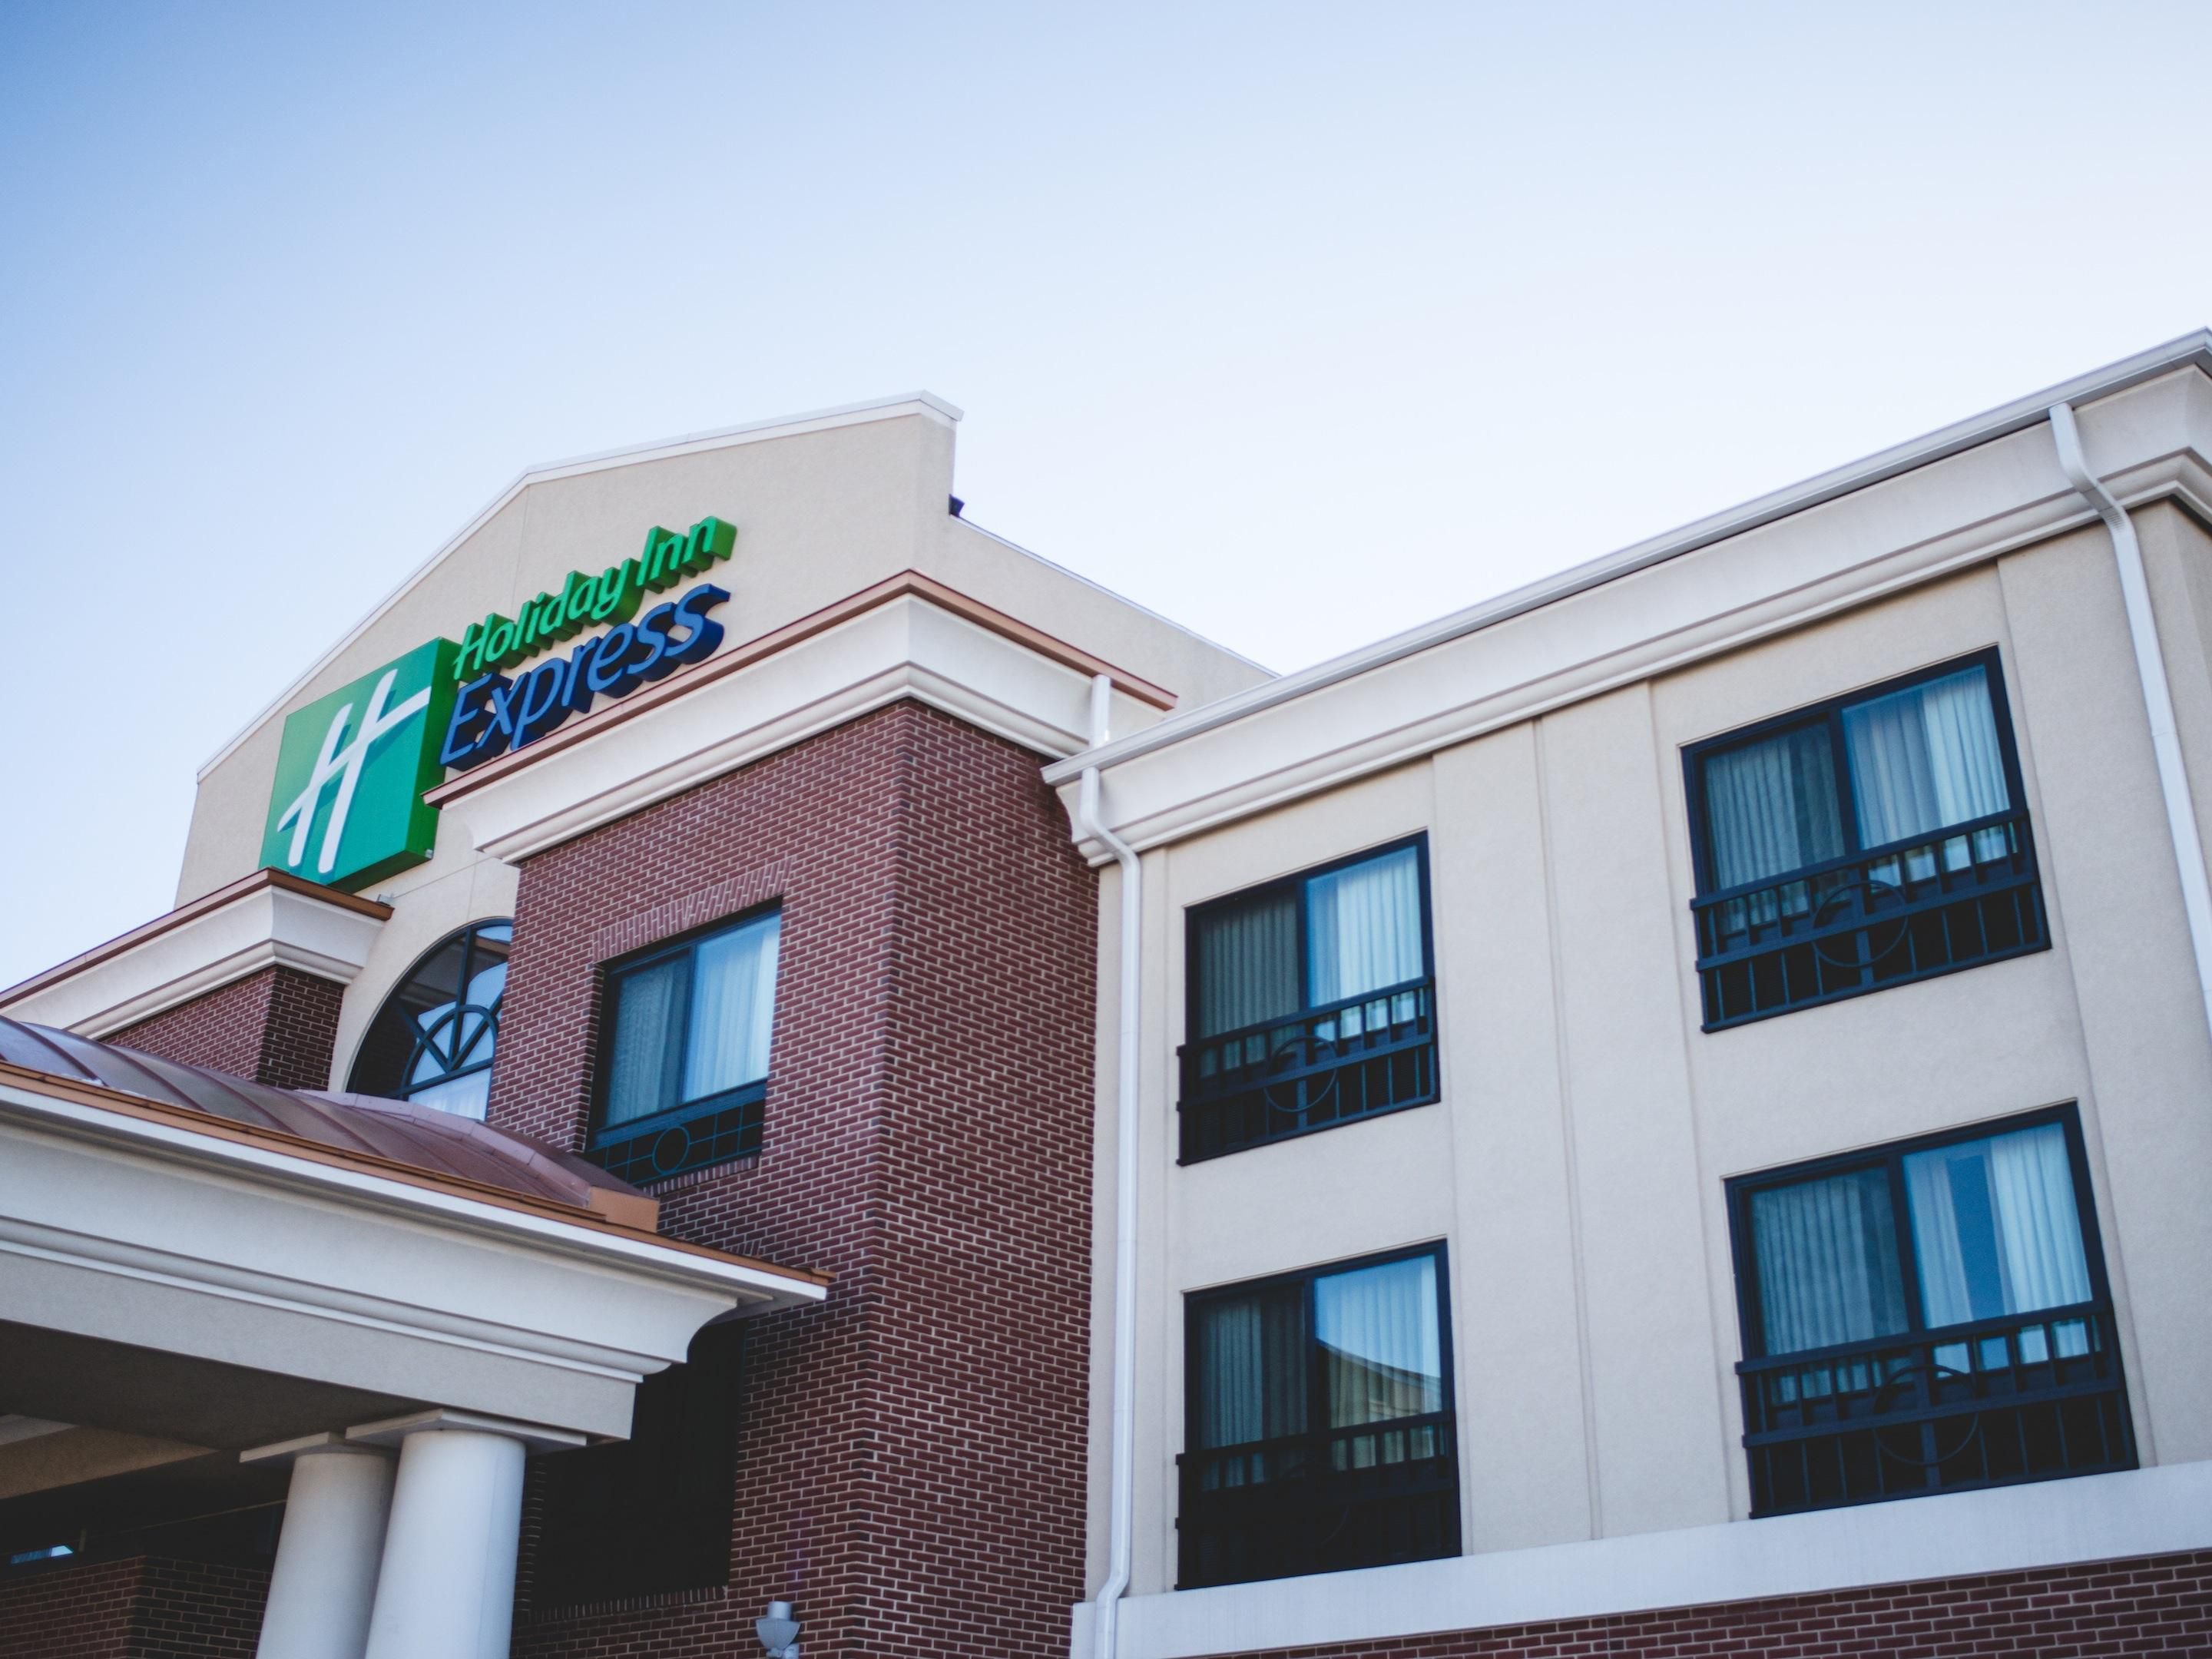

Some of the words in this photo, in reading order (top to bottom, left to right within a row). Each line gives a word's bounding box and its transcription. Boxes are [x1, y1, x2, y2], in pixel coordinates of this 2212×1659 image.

[439, 582, 731, 768] Express
[452, 558, 644, 680] Holiday
[634, 515, 728, 590] Inn
